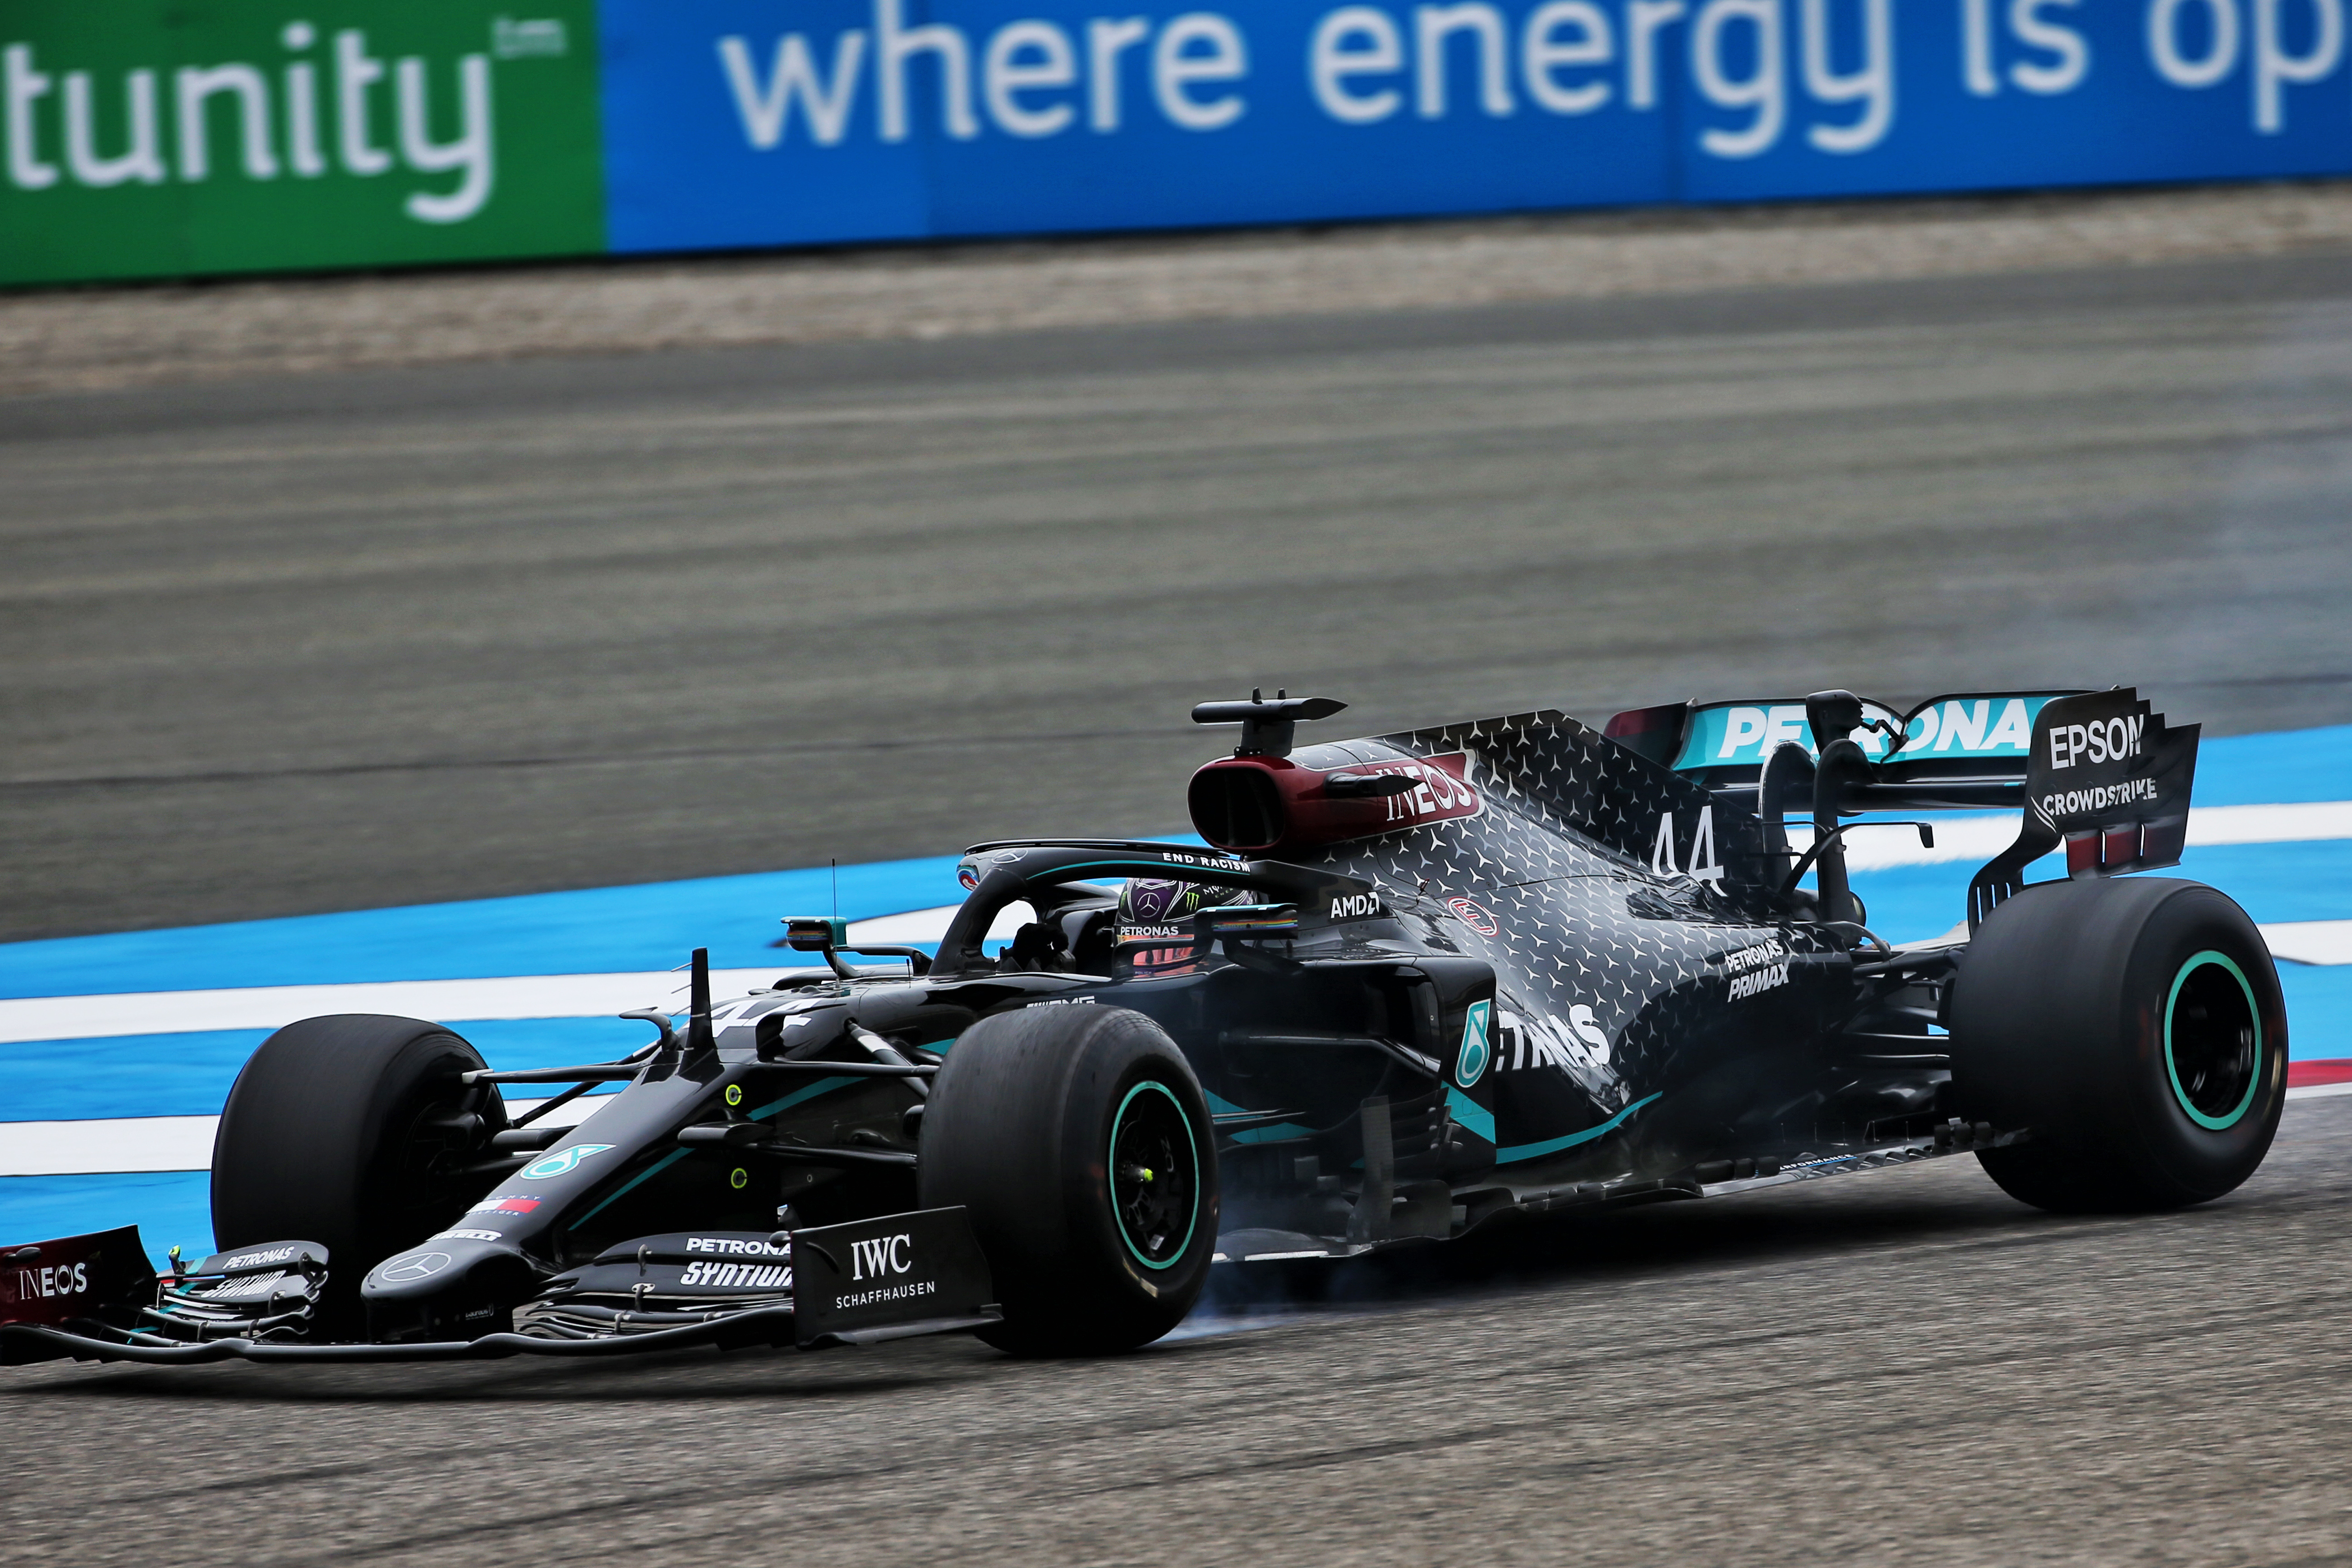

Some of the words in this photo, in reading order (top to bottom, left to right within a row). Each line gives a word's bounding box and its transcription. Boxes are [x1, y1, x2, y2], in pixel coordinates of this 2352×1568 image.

[717, 0, 1248, 150] where
[1310, 0, 1896, 158] energy
[2146, 0, 2345, 134] op
[4, 20, 495, 224] tunity
[2049, 714, 2144, 769] EPSON
[1375, 764, 1472, 821] INEOS
[2043, 778, 2157, 816] CROWDSTRIKE
[1163, 853, 1195, 863] END
[1200, 857, 1250, 872] RACISM
[1652, 805, 1729, 897] 44
[1331, 895, 1367, 918] AMD
[1121, 926, 1179, 936] PETRONAS
[1725, 939, 1784, 973] PETRONAS
[1727, 963, 1789, 1003] PRIMAX
[222, 1246, 294, 1269] PETRONAS
[851, 1234, 911, 1280] IWC
[19, 1263, 87, 1300] INEOS
[836, 1281, 935, 1309] SCHAFFHAUSEN
